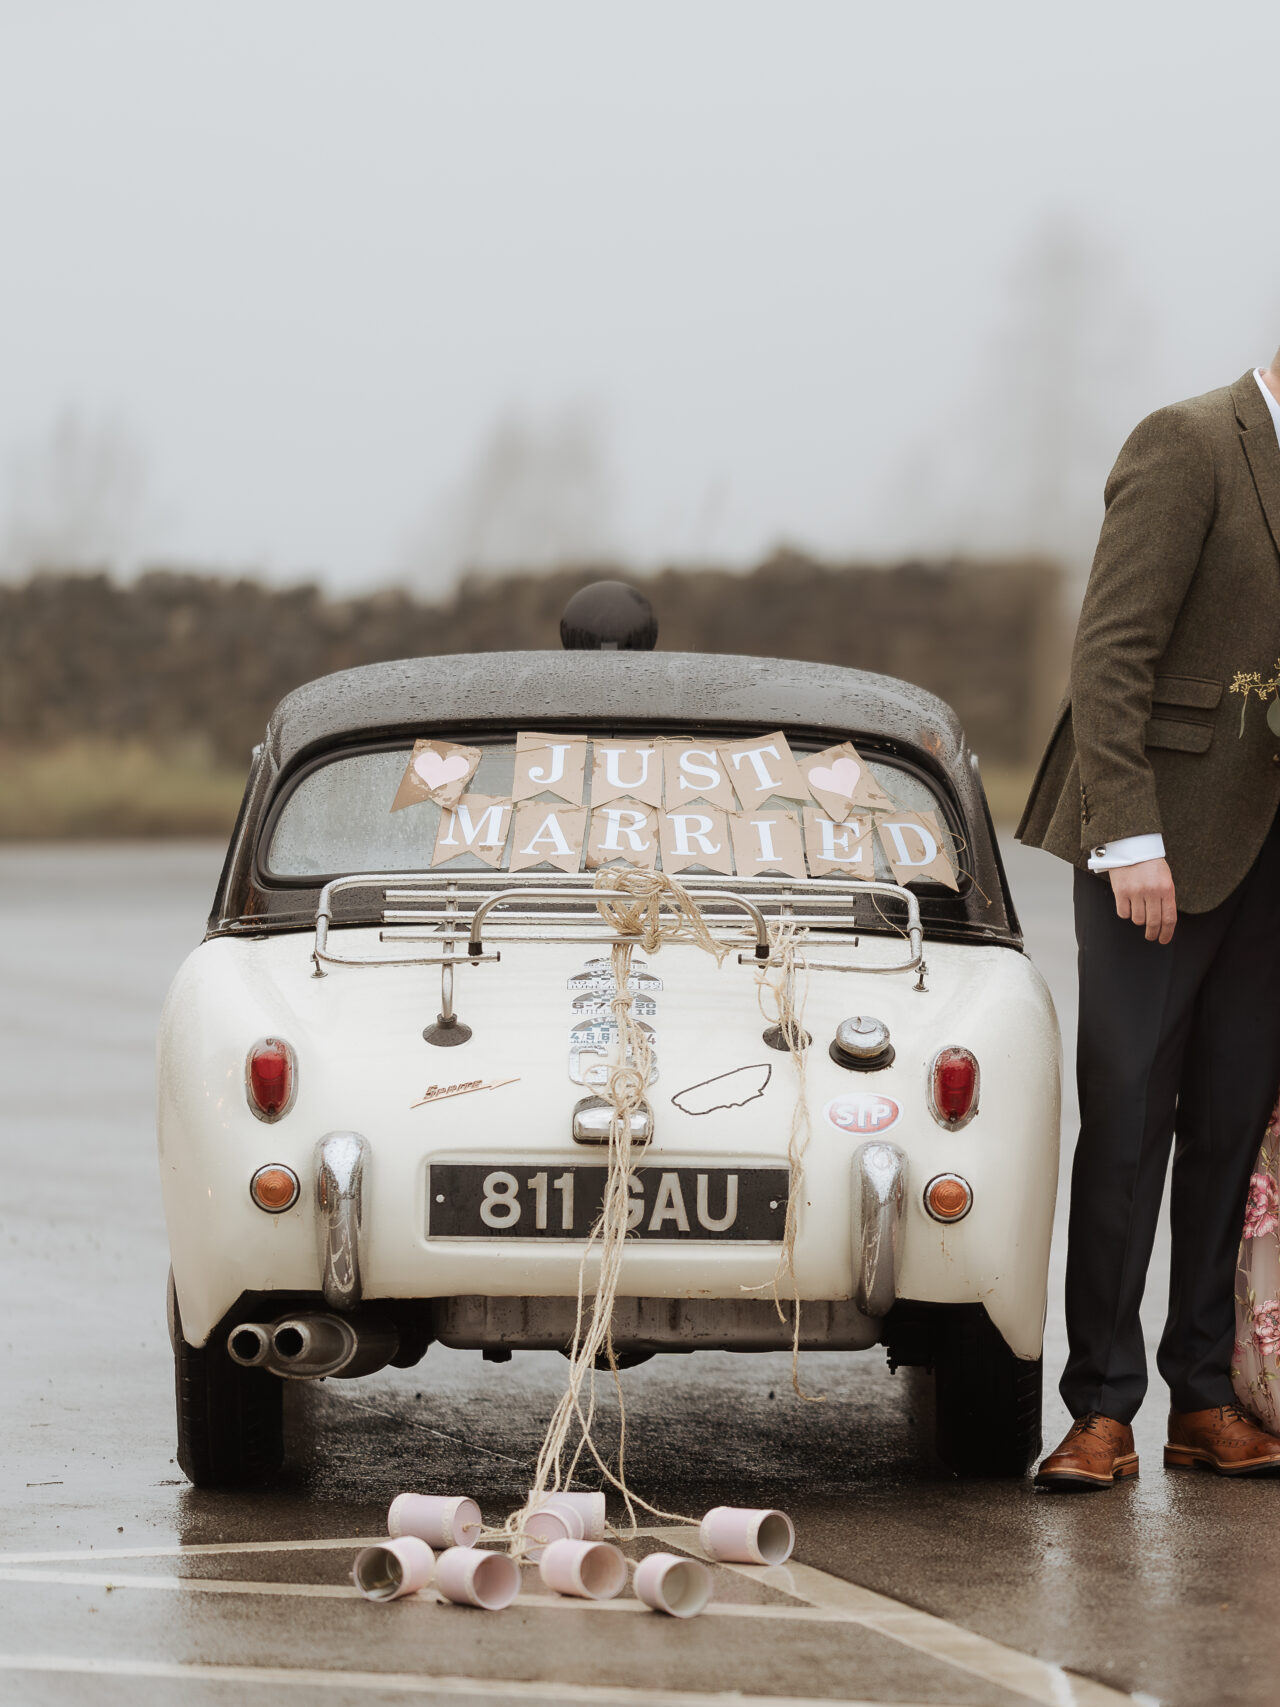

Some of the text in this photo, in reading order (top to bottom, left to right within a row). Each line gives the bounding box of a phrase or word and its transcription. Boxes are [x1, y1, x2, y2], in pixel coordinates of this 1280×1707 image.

[528, 743, 784, 792] JUST
[439, 804, 938, 867] MARRIED
[836, 1103, 892, 1128] STP
[479, 1171, 574, 1229] 811
